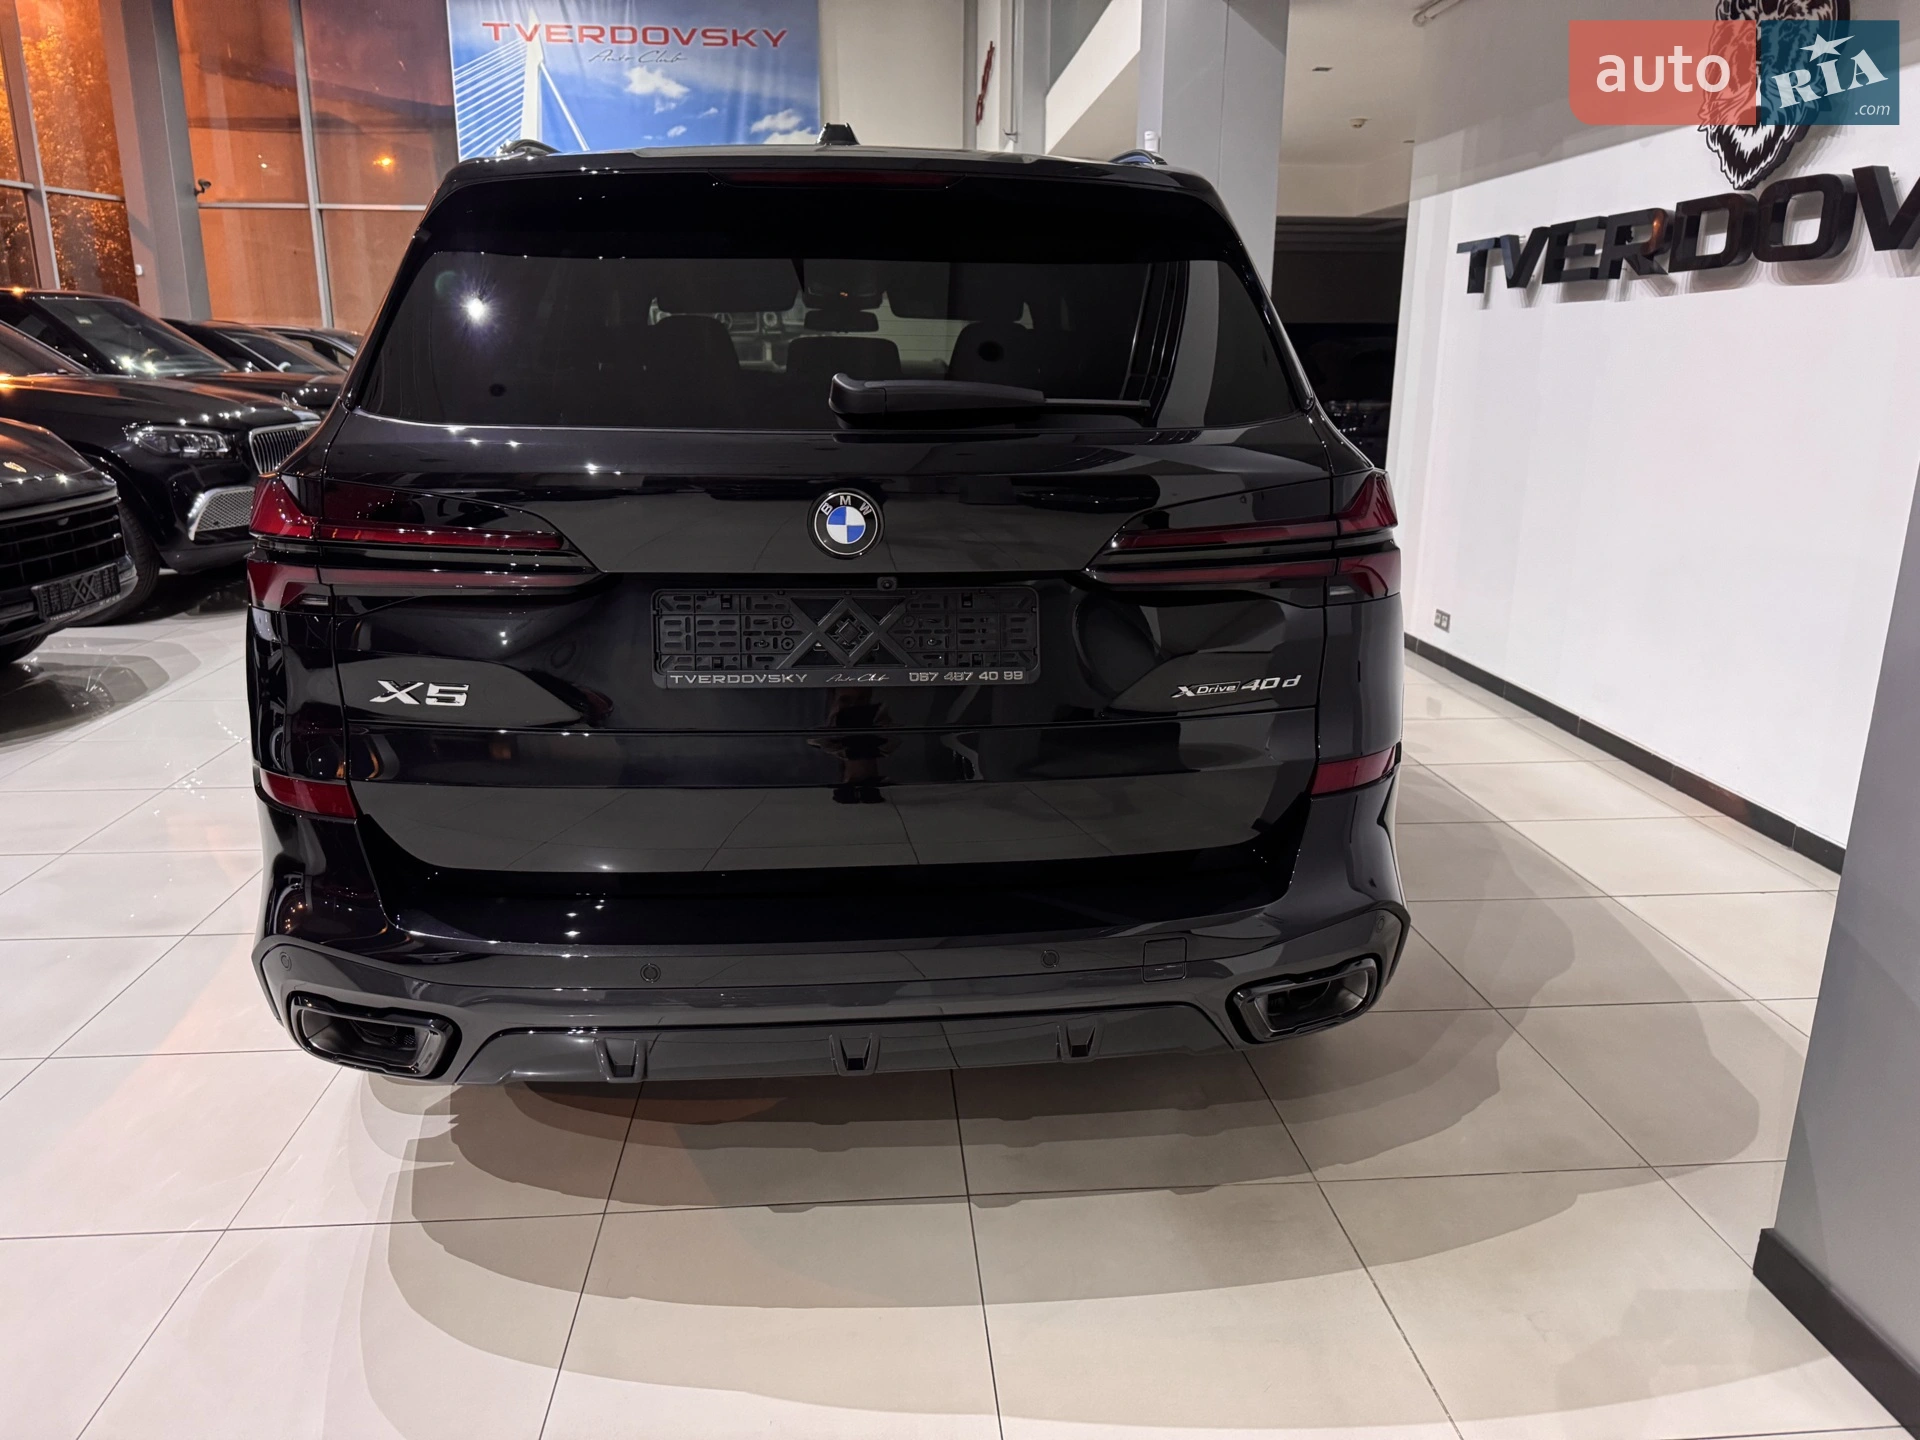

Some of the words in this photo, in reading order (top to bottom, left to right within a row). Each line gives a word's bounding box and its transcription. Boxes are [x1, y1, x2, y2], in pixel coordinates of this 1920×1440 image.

[482, 22, 788, 48] TVERDOVSKY
[821, 495, 872, 516] BMW
[670, 673, 808, 684] TVERDOVSKY
[978, 671, 999, 681] 40
[1003, 670, 1024, 681] 99
[369, 680, 469, 707] X5
